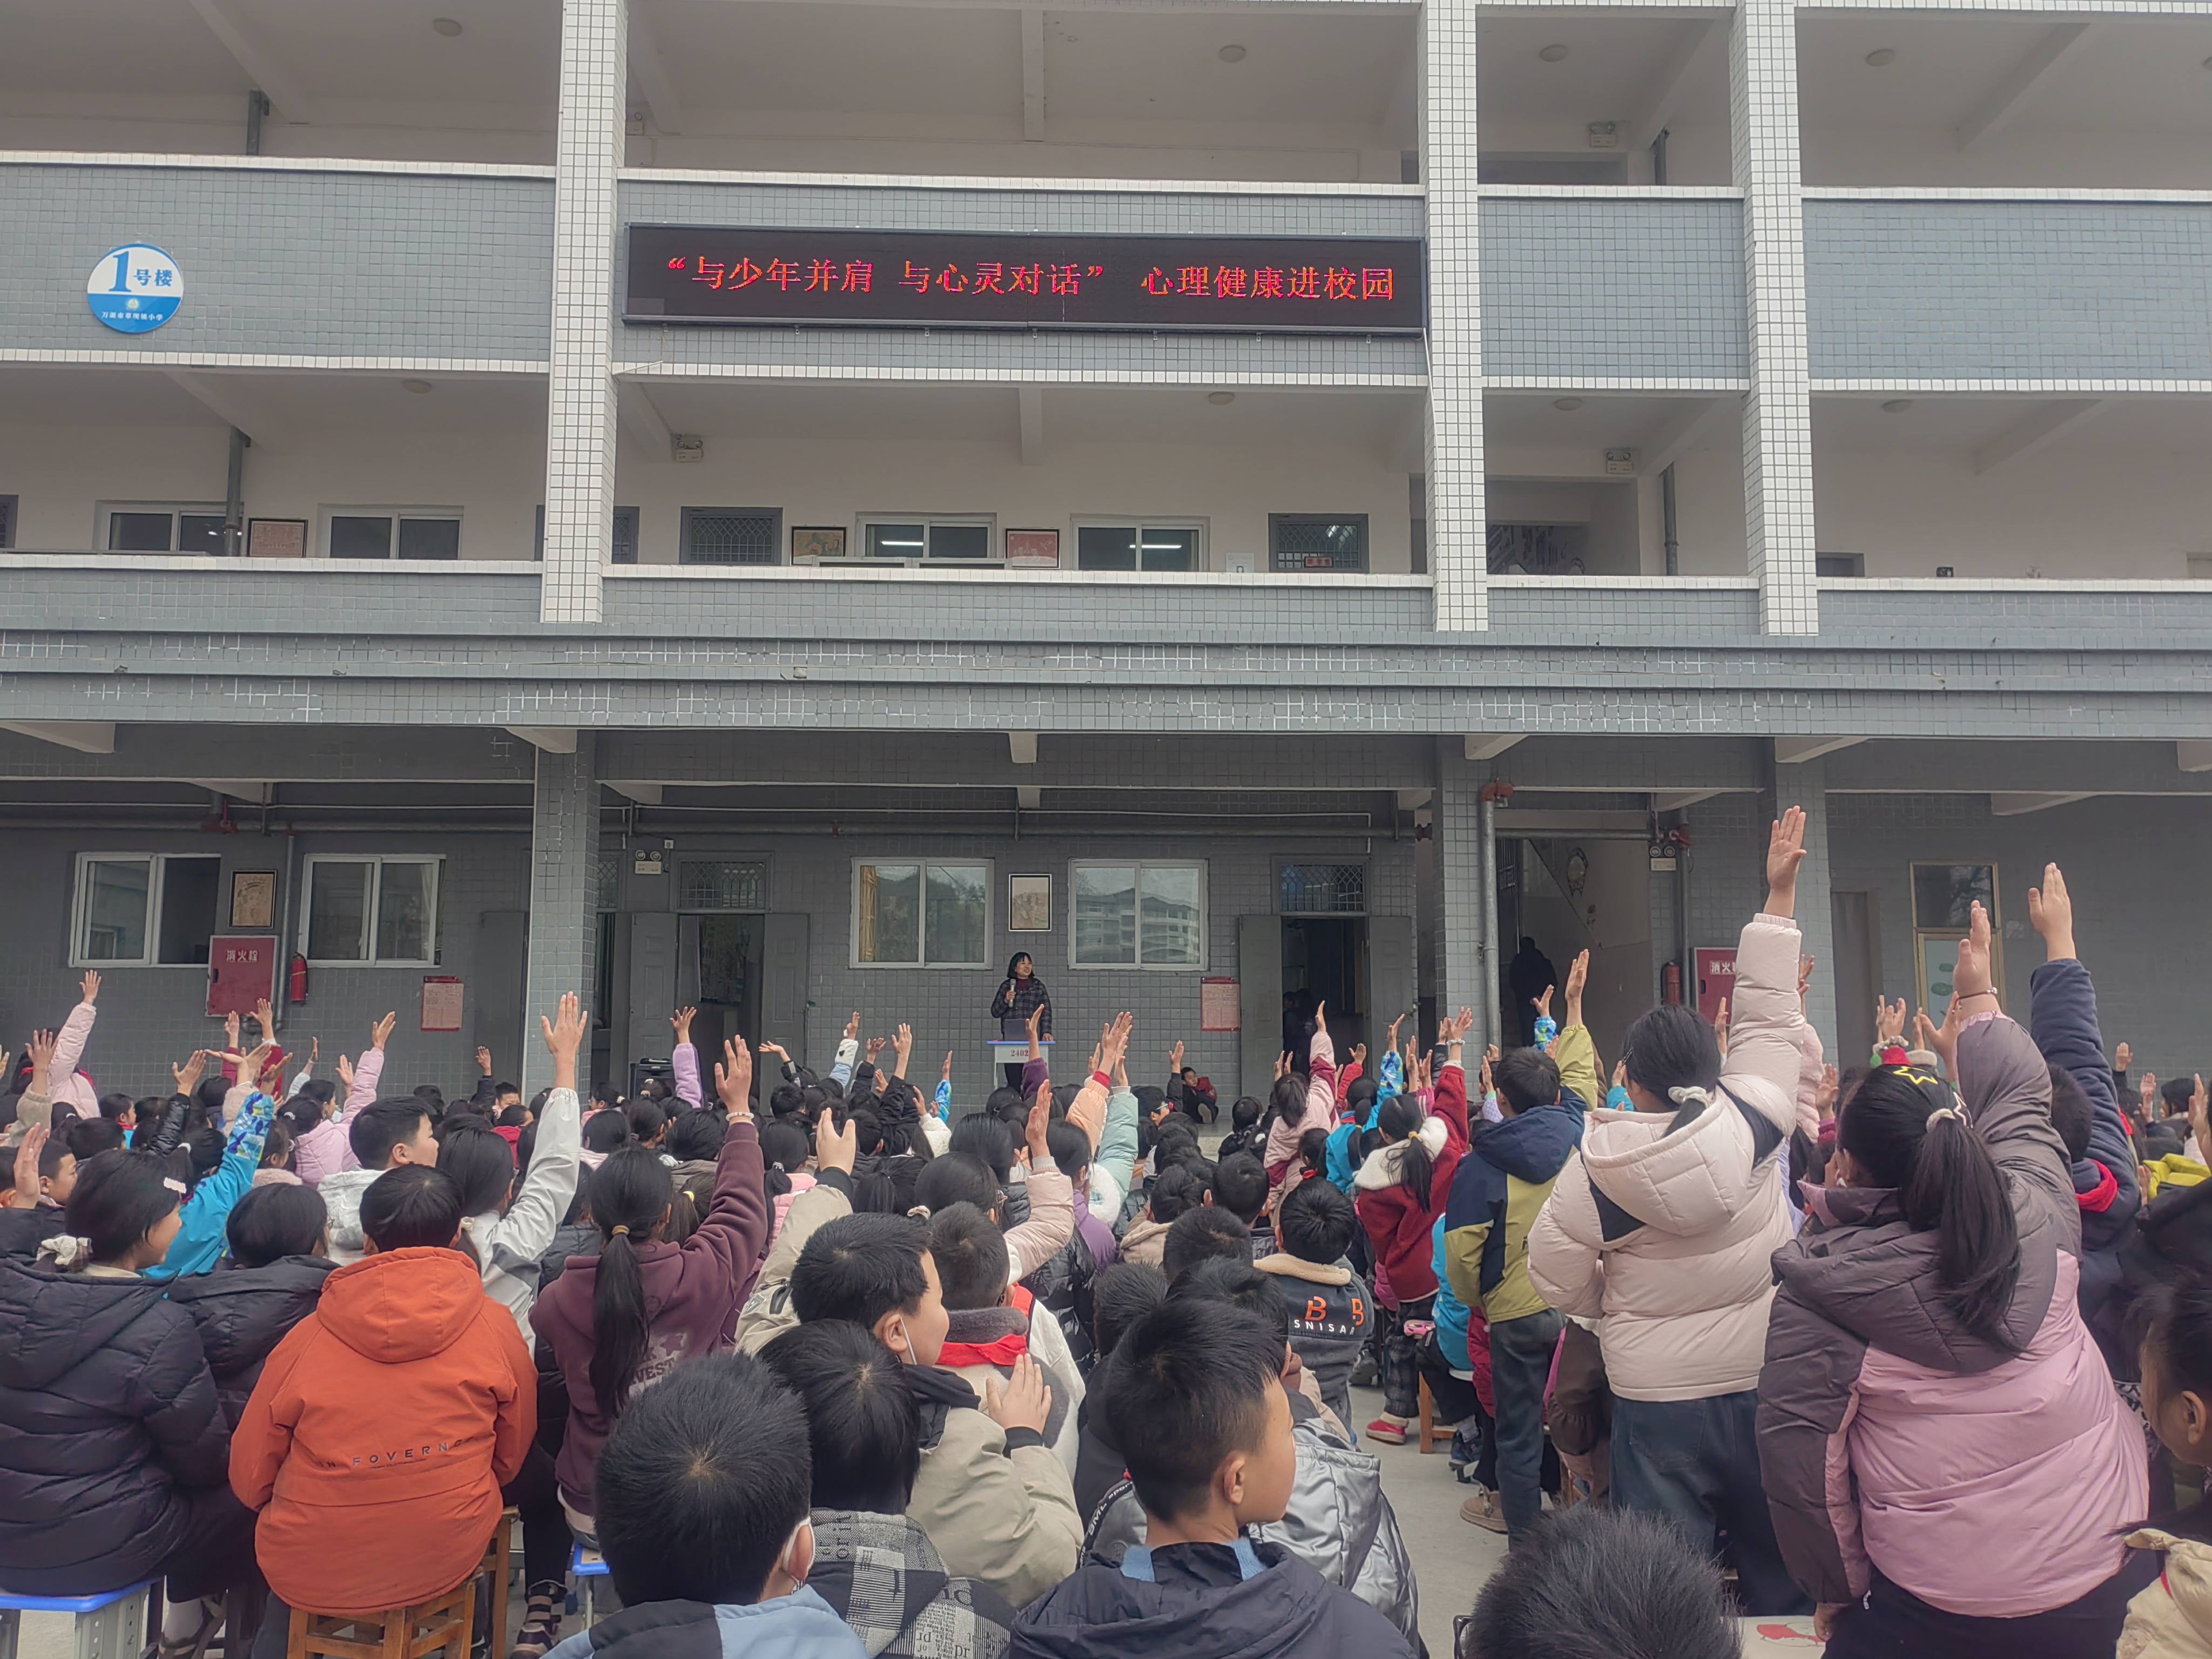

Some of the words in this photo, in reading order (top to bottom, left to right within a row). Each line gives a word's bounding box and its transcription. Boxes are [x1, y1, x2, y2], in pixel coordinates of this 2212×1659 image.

[109, 251, 172, 292] 1号楼
[1141, 265, 1394, 300] 心理健康进校园
